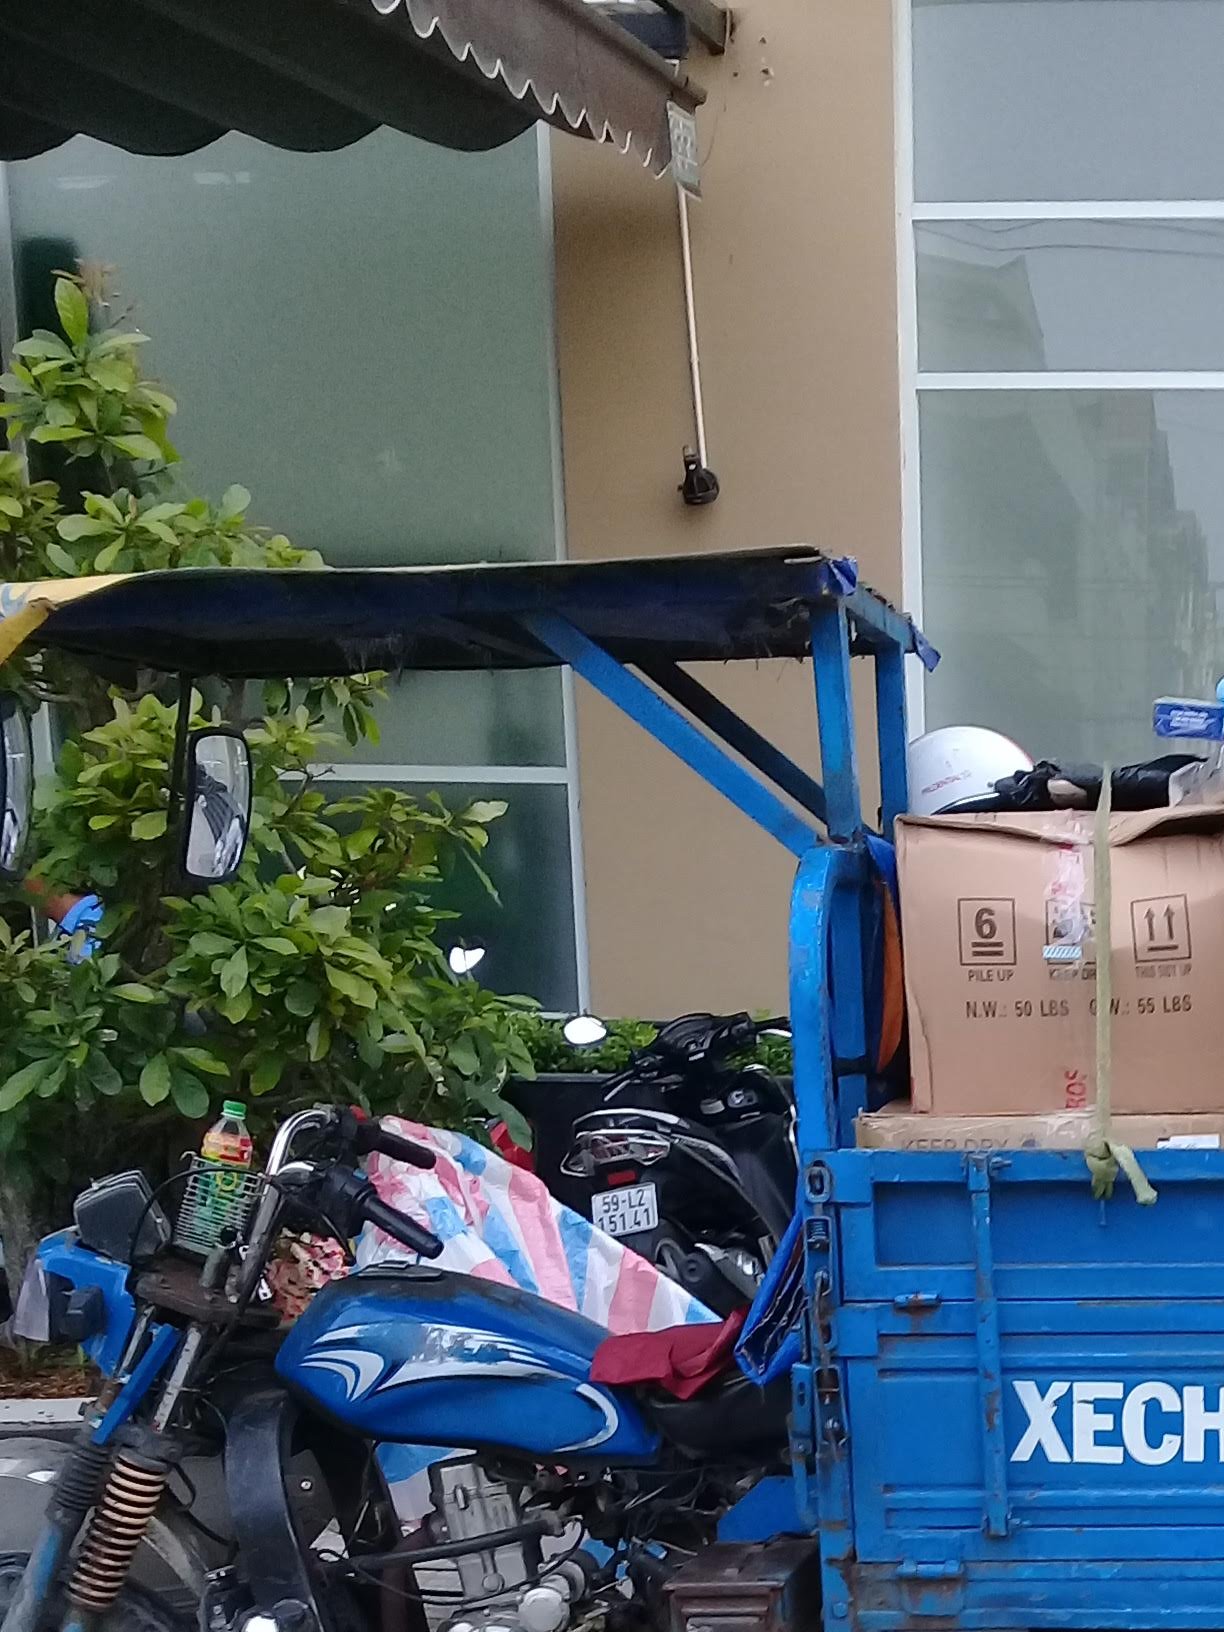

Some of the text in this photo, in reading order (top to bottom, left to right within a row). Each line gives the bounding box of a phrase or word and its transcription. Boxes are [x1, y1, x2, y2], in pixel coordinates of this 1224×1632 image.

[974, 907, 997, 939] 6
[968, 969, 1014, 982] PILE UP
[1015, 1001, 1032, 1017] 50
[1040, 1001, 1069, 1017] LBS
[1163, 994, 1192, 1013] LBS
[602, 1188, 646, 1214] 59-L2
[598, 1207, 650, 1233] 151.41
